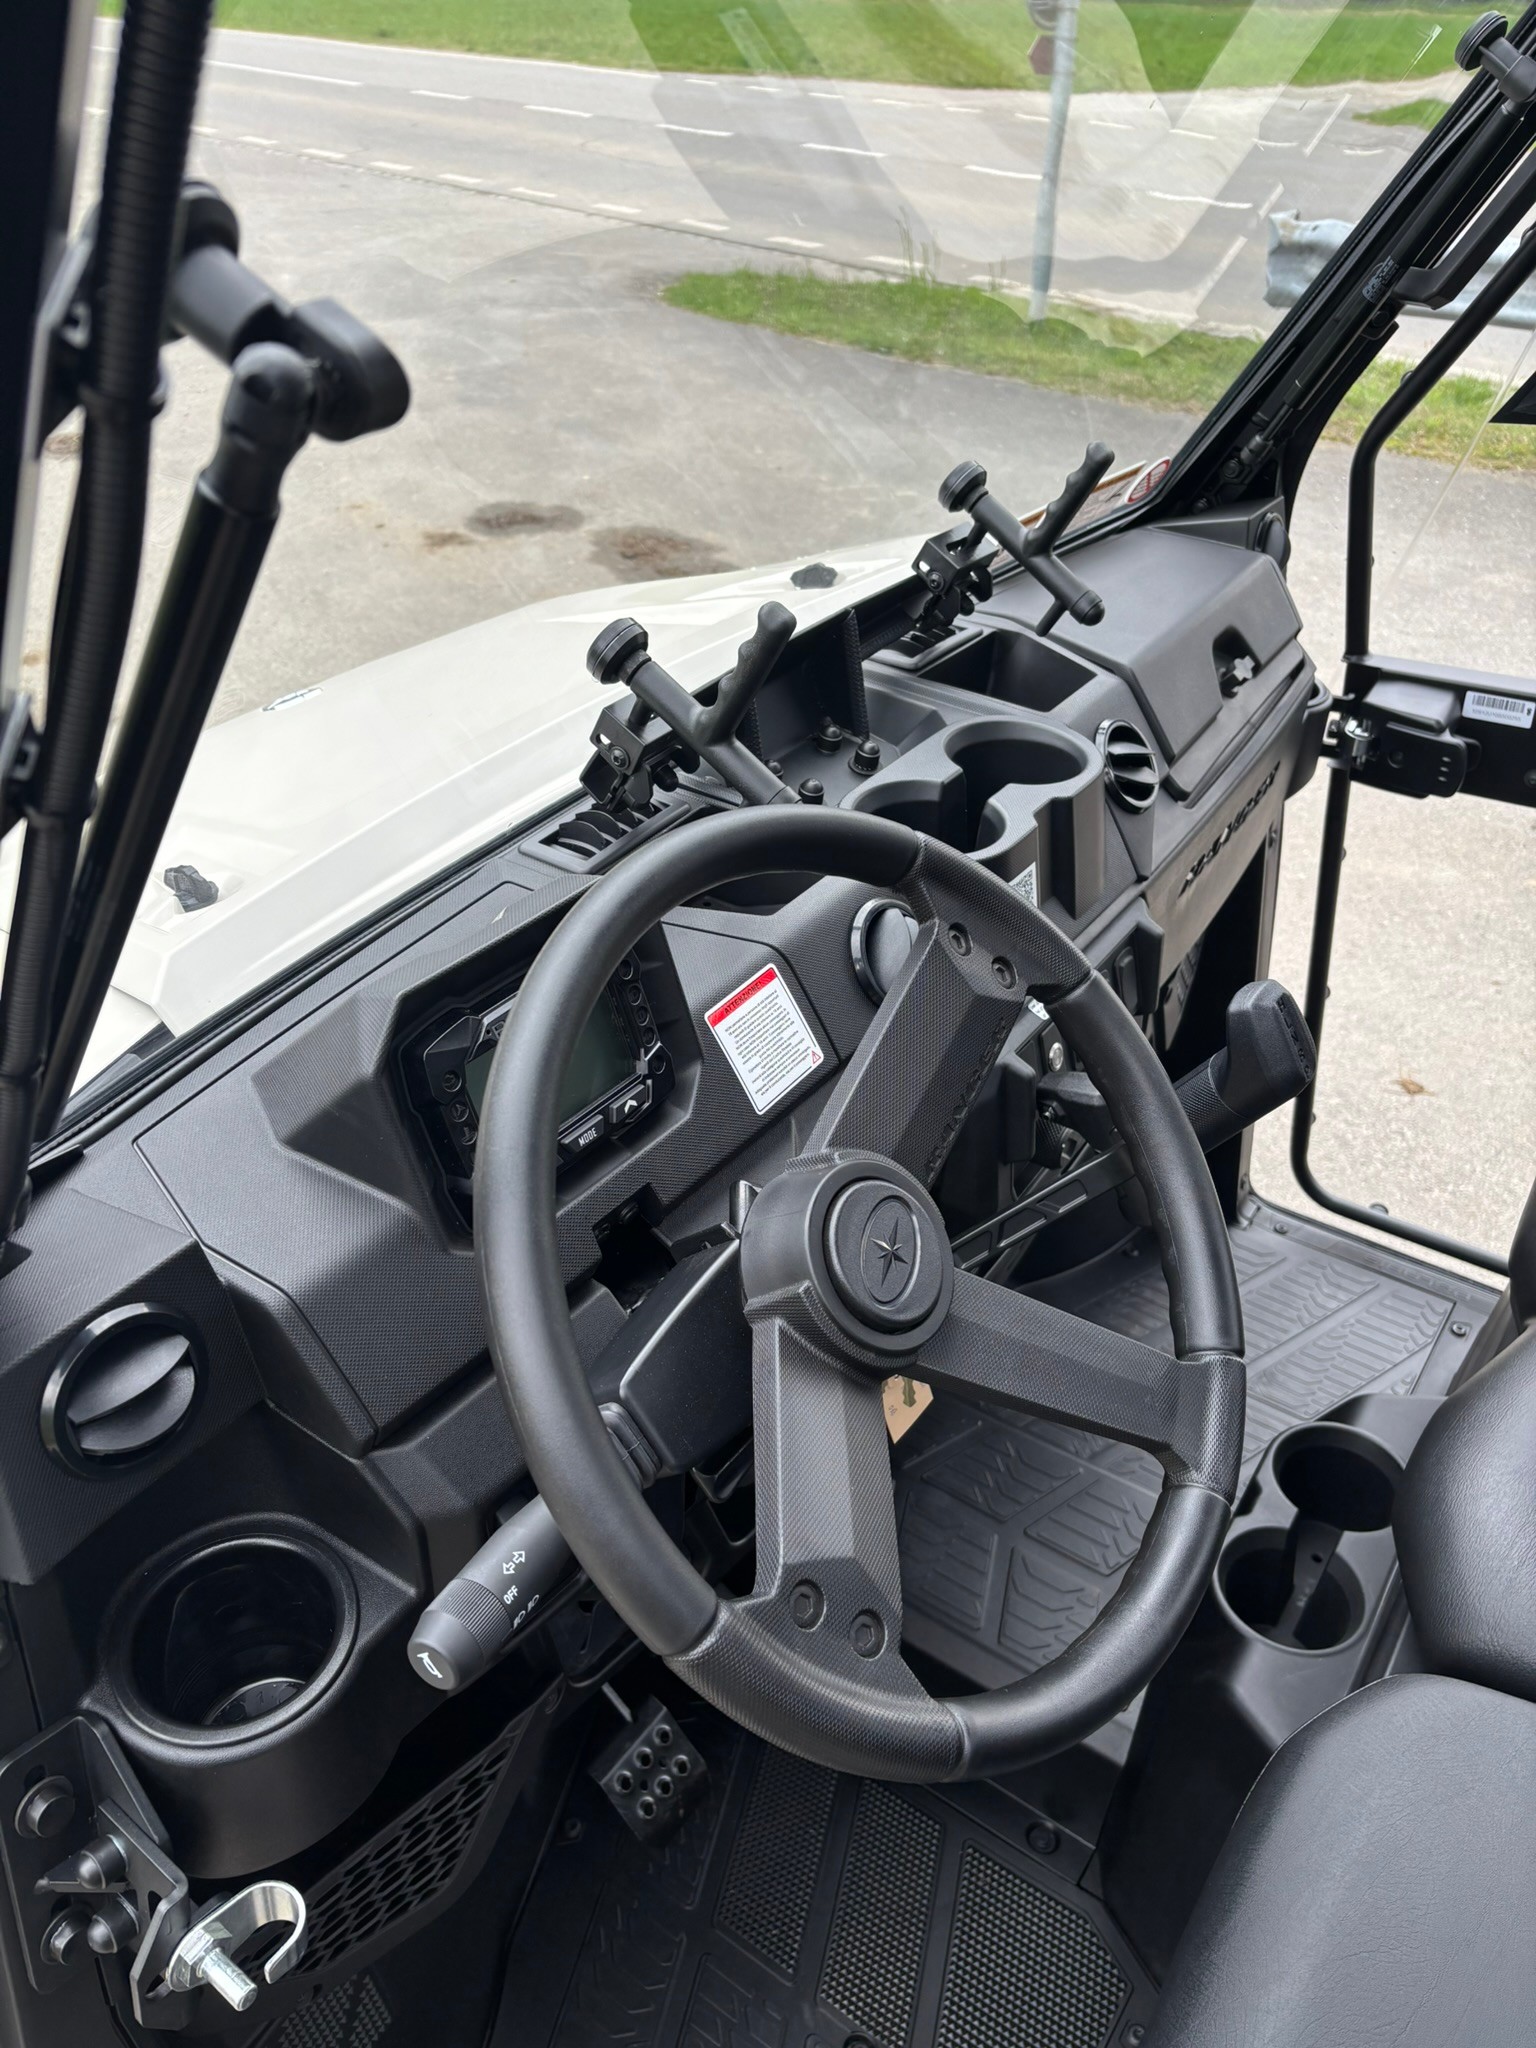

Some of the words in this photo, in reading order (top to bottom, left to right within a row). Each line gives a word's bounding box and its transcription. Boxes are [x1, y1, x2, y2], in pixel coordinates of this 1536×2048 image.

[724, 981, 762, 1014] ATTENZIONE!
[578, 1127, 597, 1147] MODE
[503, 1585, 518, 1604] OFF
